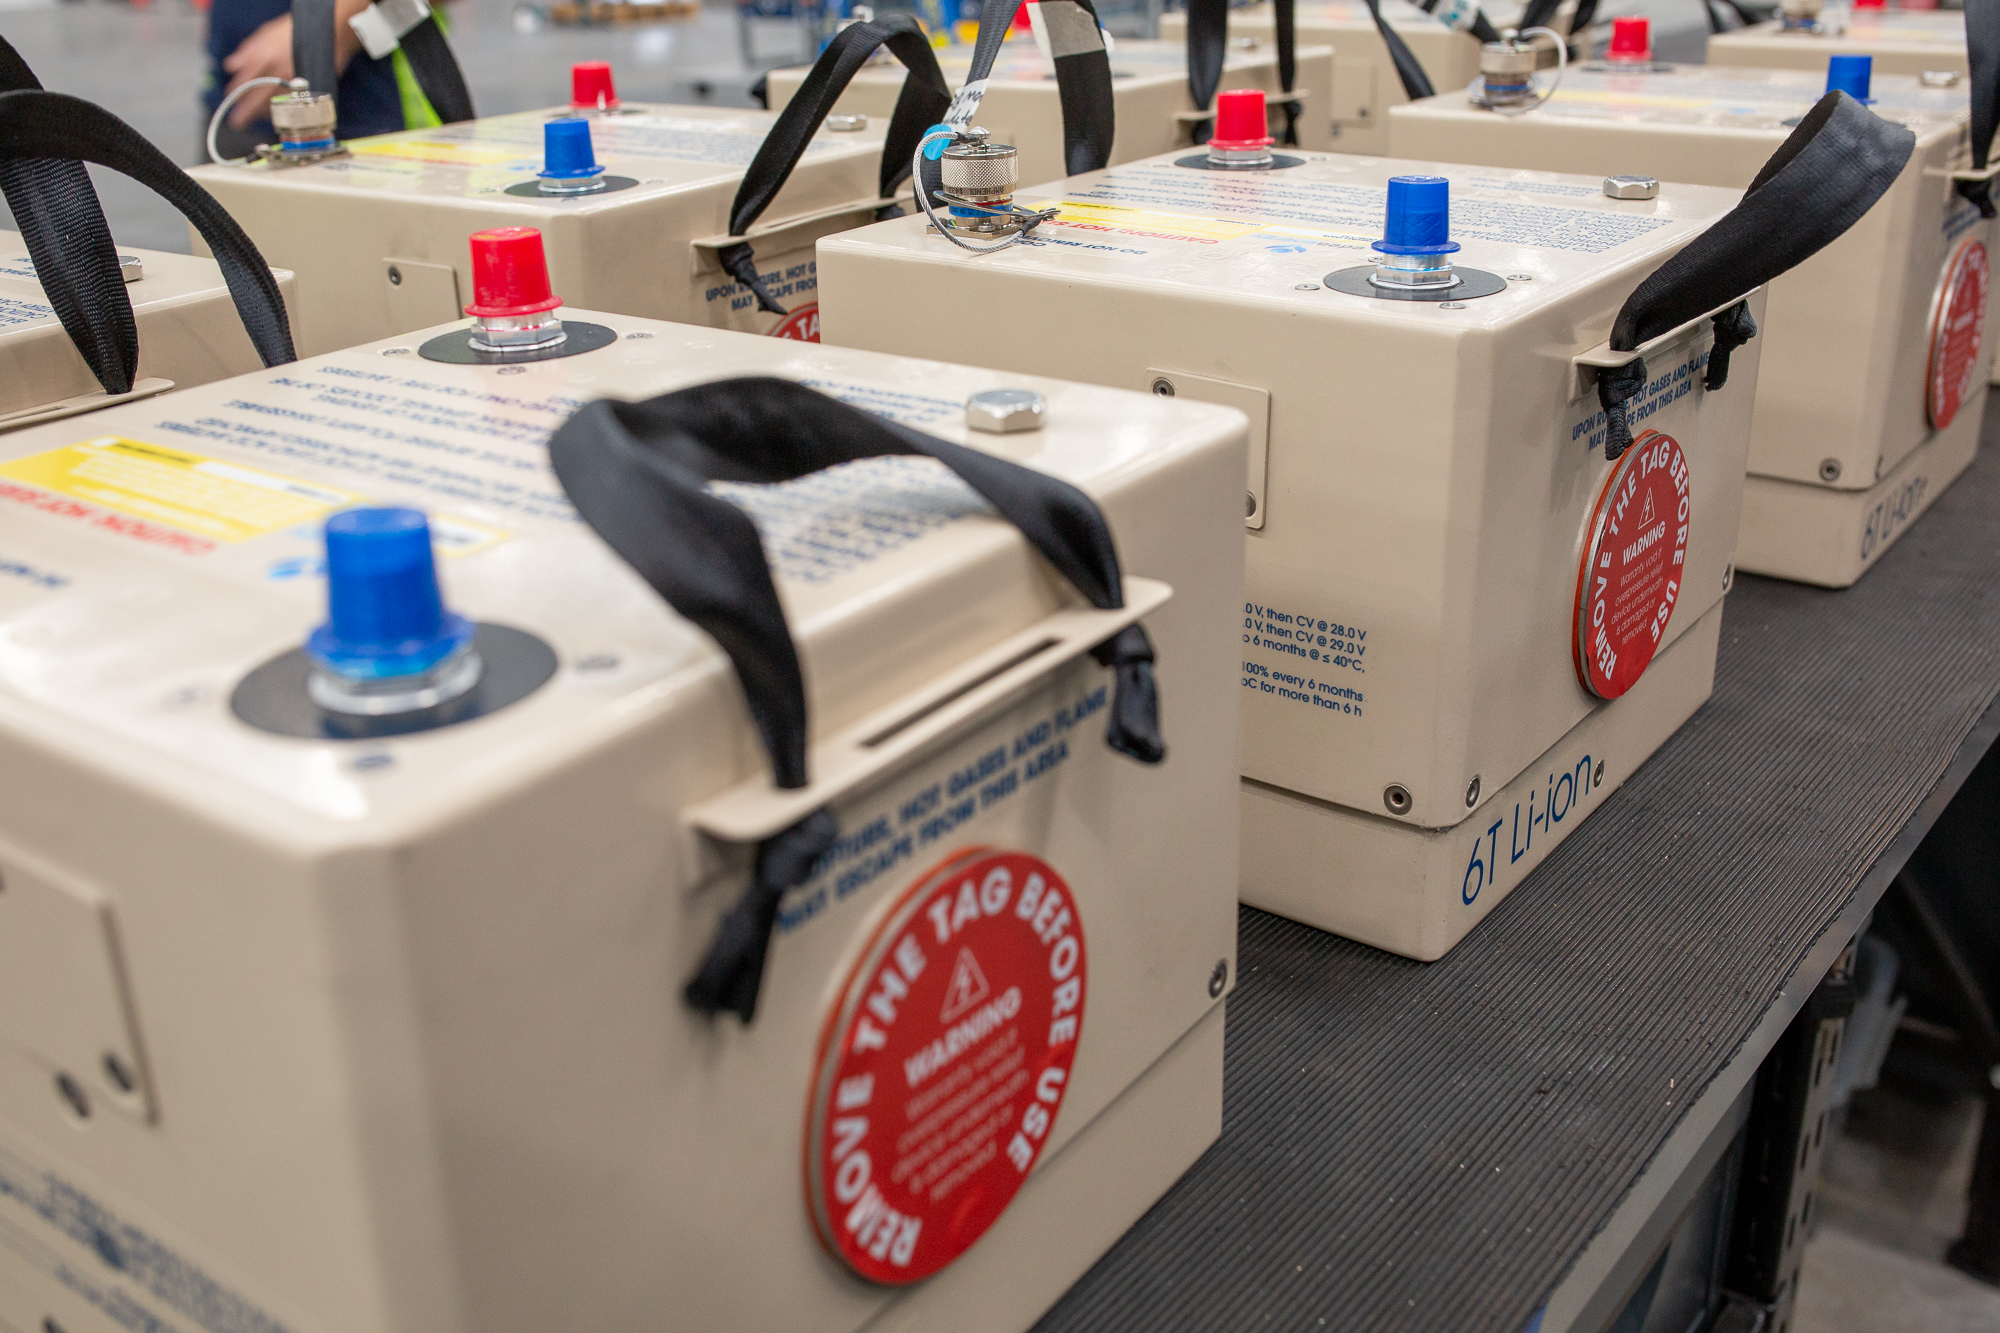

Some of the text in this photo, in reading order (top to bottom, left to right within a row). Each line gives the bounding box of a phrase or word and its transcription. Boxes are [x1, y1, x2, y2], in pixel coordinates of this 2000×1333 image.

[969, 186, 1005, 196] AMPHENOL
[1067, 223, 1116, 232] HOT
[1118, 229, 1220, 245] CAUTION:
[705, 283, 737, 302] UPON
[731, 295, 754, 311] MAY
[1572, 415, 1596, 441] UPON
[1632, 385, 1648, 407] HOT
[1649, 372, 1672, 397] GASES
[1672, 363, 1688, 387] AND
[1636, 401, 1658, 425] FROM
[1658, 389, 1674, 412] THIS
[1674, 379, 1693, 404] AREA
[1588, 427, 1608, 451] MAY
[1593, 440, 1690, 681] REMOVE THE TAG BEFORE USE
[1622, 520, 1667, 567] WARNING
[1613, 559, 1665, 607] overpressure relief
[1619, 560, 1647, 588] Warranty
[1645, 549, 1659, 573] void
[1610, 576, 1665, 626] device underneath
[1620, 605, 1650, 634] damaged
[1254, 604, 1264, 618] V,
[1266, 607, 1293, 624] then
[1296, 615, 1315, 628] CV
[1317, 620, 1328, 632] @
[1330, 623, 1356, 639] 28.0
[1357, 629, 1367, 641] V
[1254, 619, 1264, 633] V,
[1265, 622, 1293, 639] then
[1295, 630, 1314, 643] CV
[1316, 635, 1328, 647] @
[1329, 638, 1355, 654] 29.0
[1356, 644, 1366, 656] V
[1621, 621, 1648, 647] removed
[1252, 634, 1261, 646] 6
[1263, 638, 1307, 658] months
[1309, 648, 1320, 661] @
[1332, 654, 1366, 674] 40°C,
[1242, 660, 1364, 702] 100% every 6 months
[1260, 680, 1276, 693] for
[1278, 686, 1310, 703] more
[1312, 694, 1341, 711] than
[1343, 702, 1351, 714] 6
[1353, 704, 1362, 717] h
[1462, 754, 1592, 906] 6T Li-ion
[903, 985, 1023, 1089] WARNING
[832, 865, 1081, 1267] REMOVE THE TAG BEFORE USE
